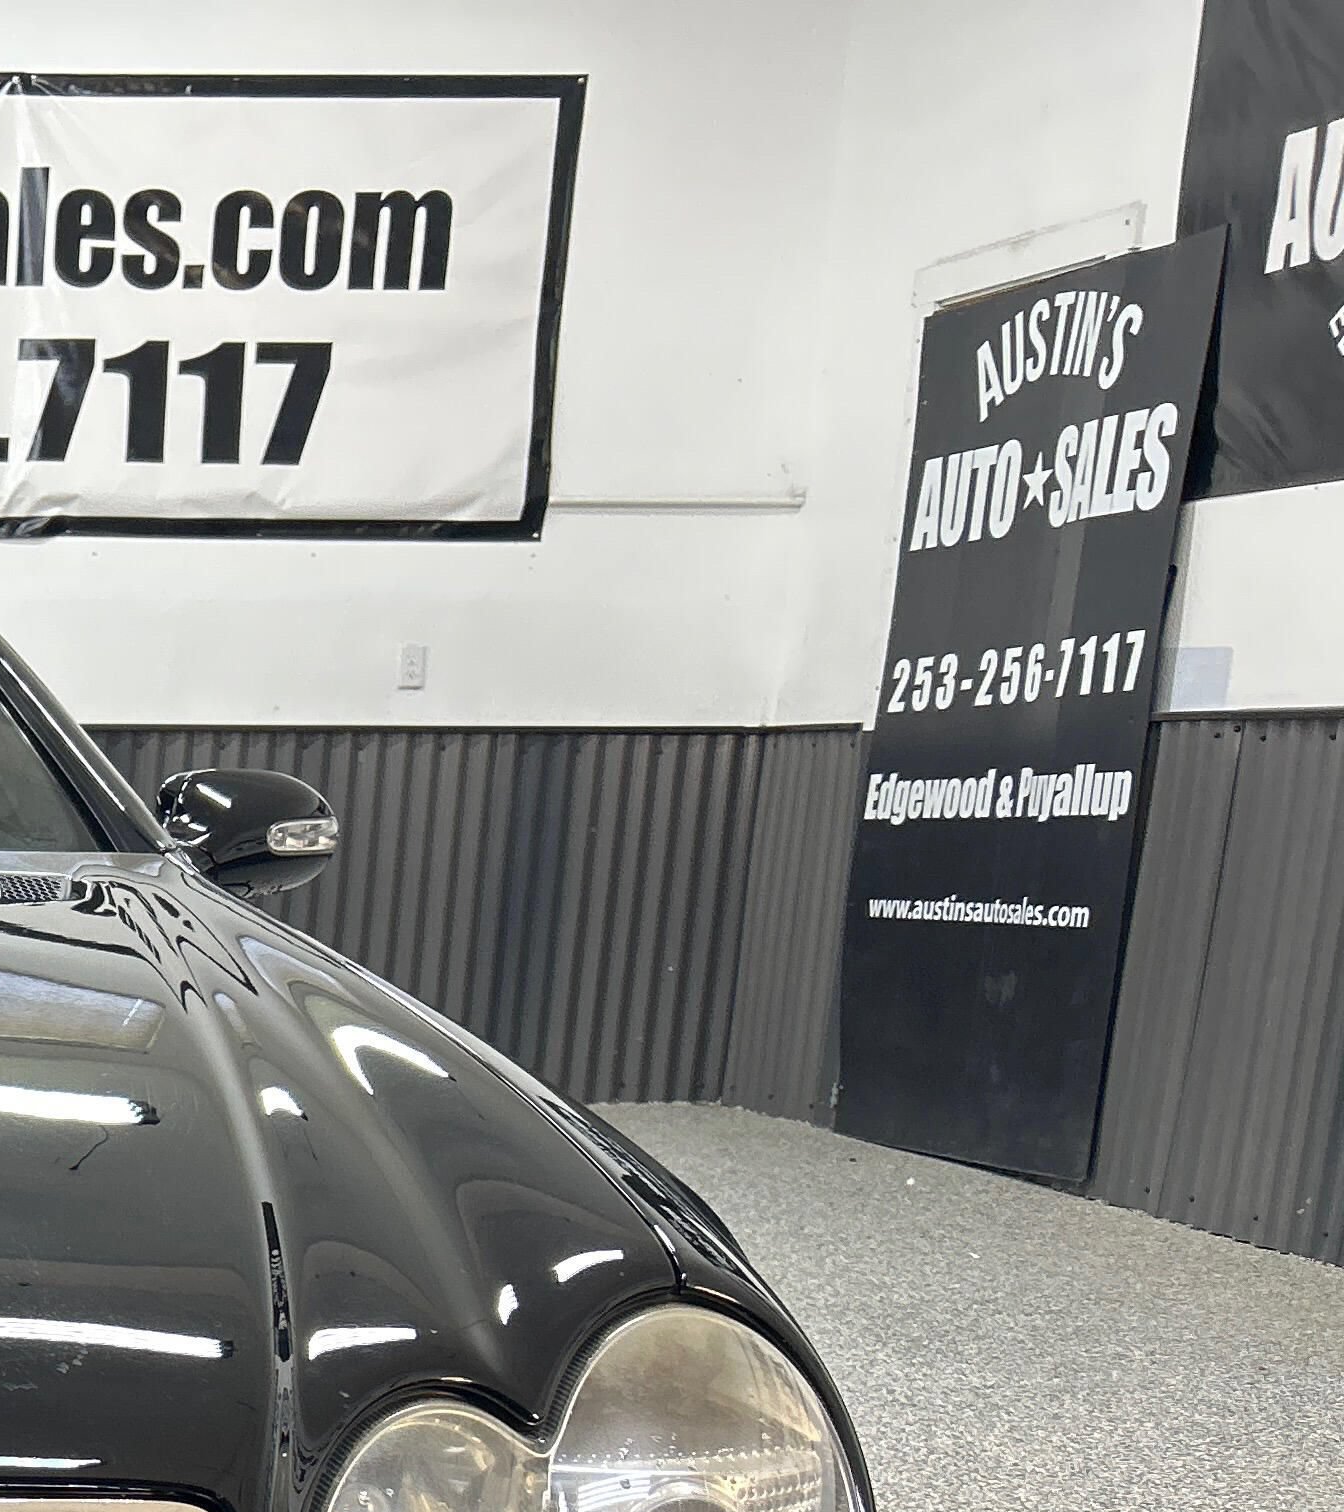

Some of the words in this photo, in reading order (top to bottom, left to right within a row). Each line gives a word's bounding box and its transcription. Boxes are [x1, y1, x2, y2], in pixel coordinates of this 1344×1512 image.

[976, 290, 1144, 422] AUSTIN'S
[909, 439, 1022, 552] AUTO
[1048, 402, 1178, 528] SALES
[887, 629, 1146, 713] 253-256-7117
[864, 768, 997, 826] Edgewood
[995, 775, 1014, 819] &
[1015, 763, 1133, 823] Puyallup
[869, 894, 1090, 928] www.austinsautosales.com
